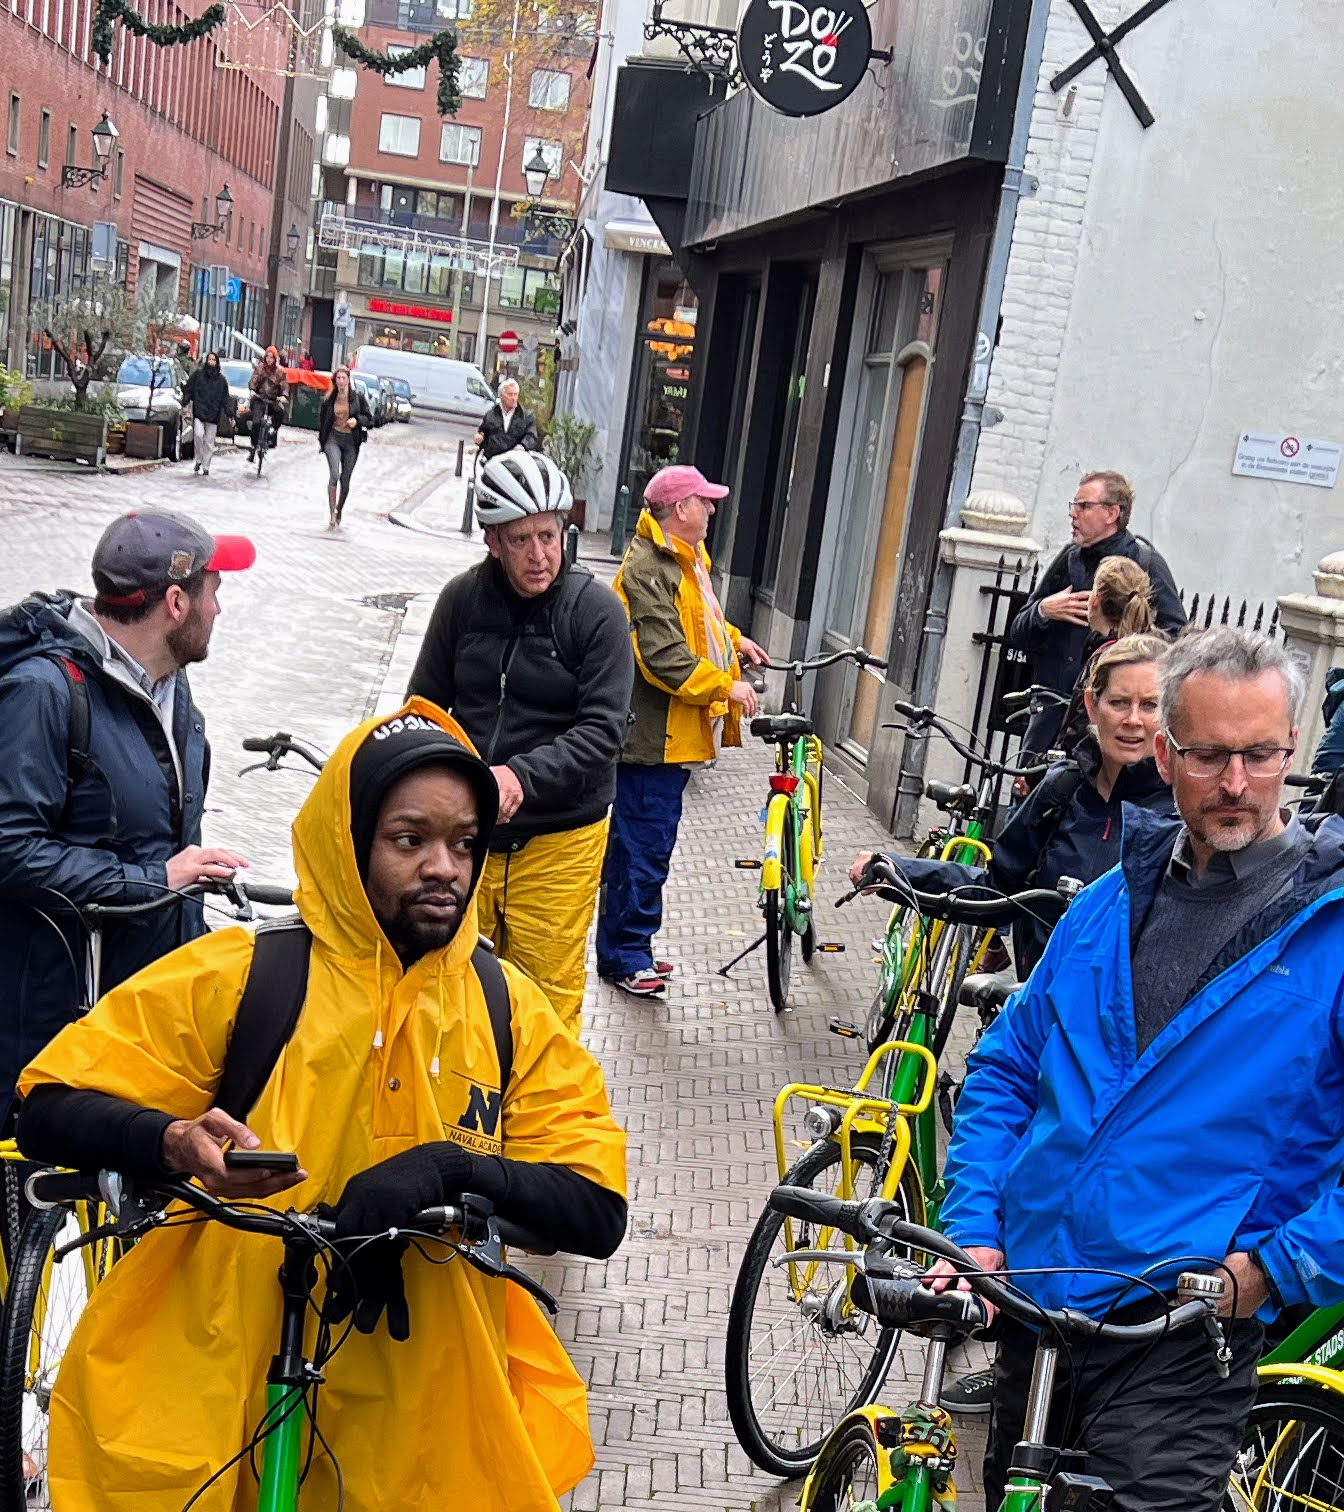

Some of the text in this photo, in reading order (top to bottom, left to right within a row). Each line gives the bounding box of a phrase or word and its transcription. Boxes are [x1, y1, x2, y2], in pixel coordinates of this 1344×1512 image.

[768, 0, 836, 39] DO
[780, 39, 843, 91] ZO
[449, 1130, 476, 1148] NAVAL
